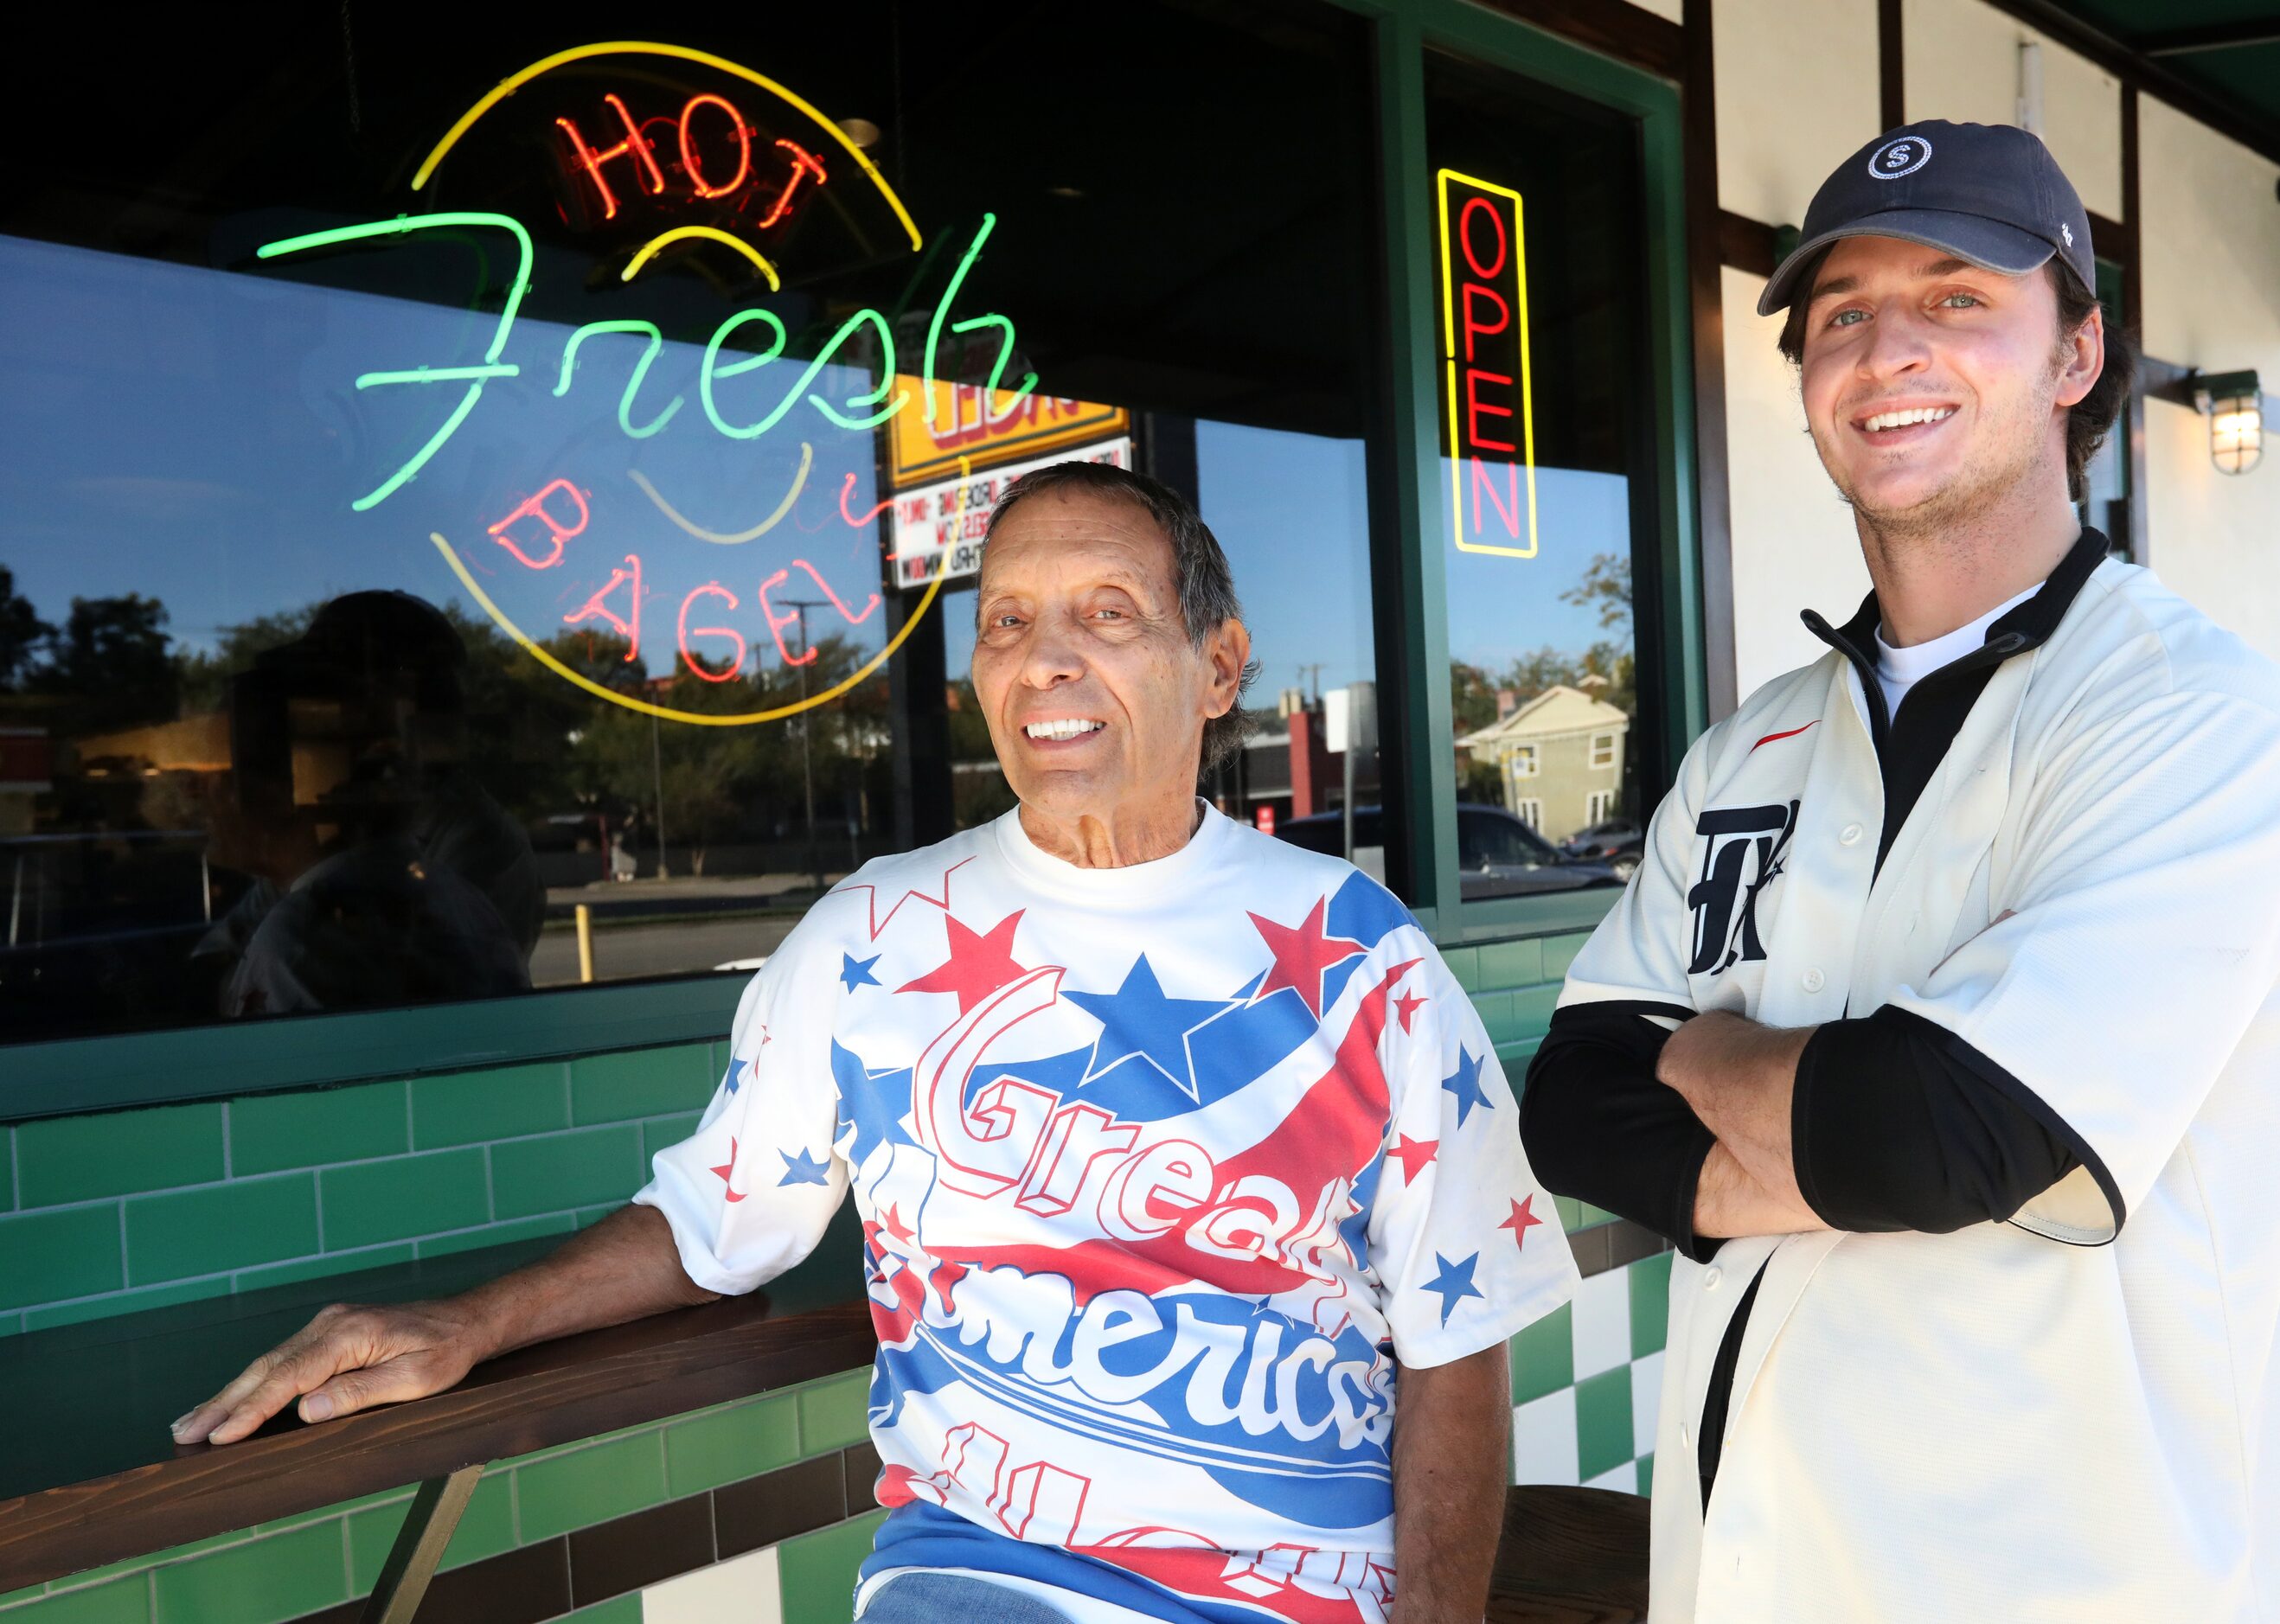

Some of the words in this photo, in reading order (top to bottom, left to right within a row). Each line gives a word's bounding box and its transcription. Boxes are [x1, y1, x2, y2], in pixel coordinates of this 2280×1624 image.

[556, 93, 828, 228] HOT
[1886, 144, 1911, 168] S
[257, 212, 1038, 512] Fresh
[1459, 196, 1521, 538] OPEN
[487, 472, 913, 682] BAGELS
